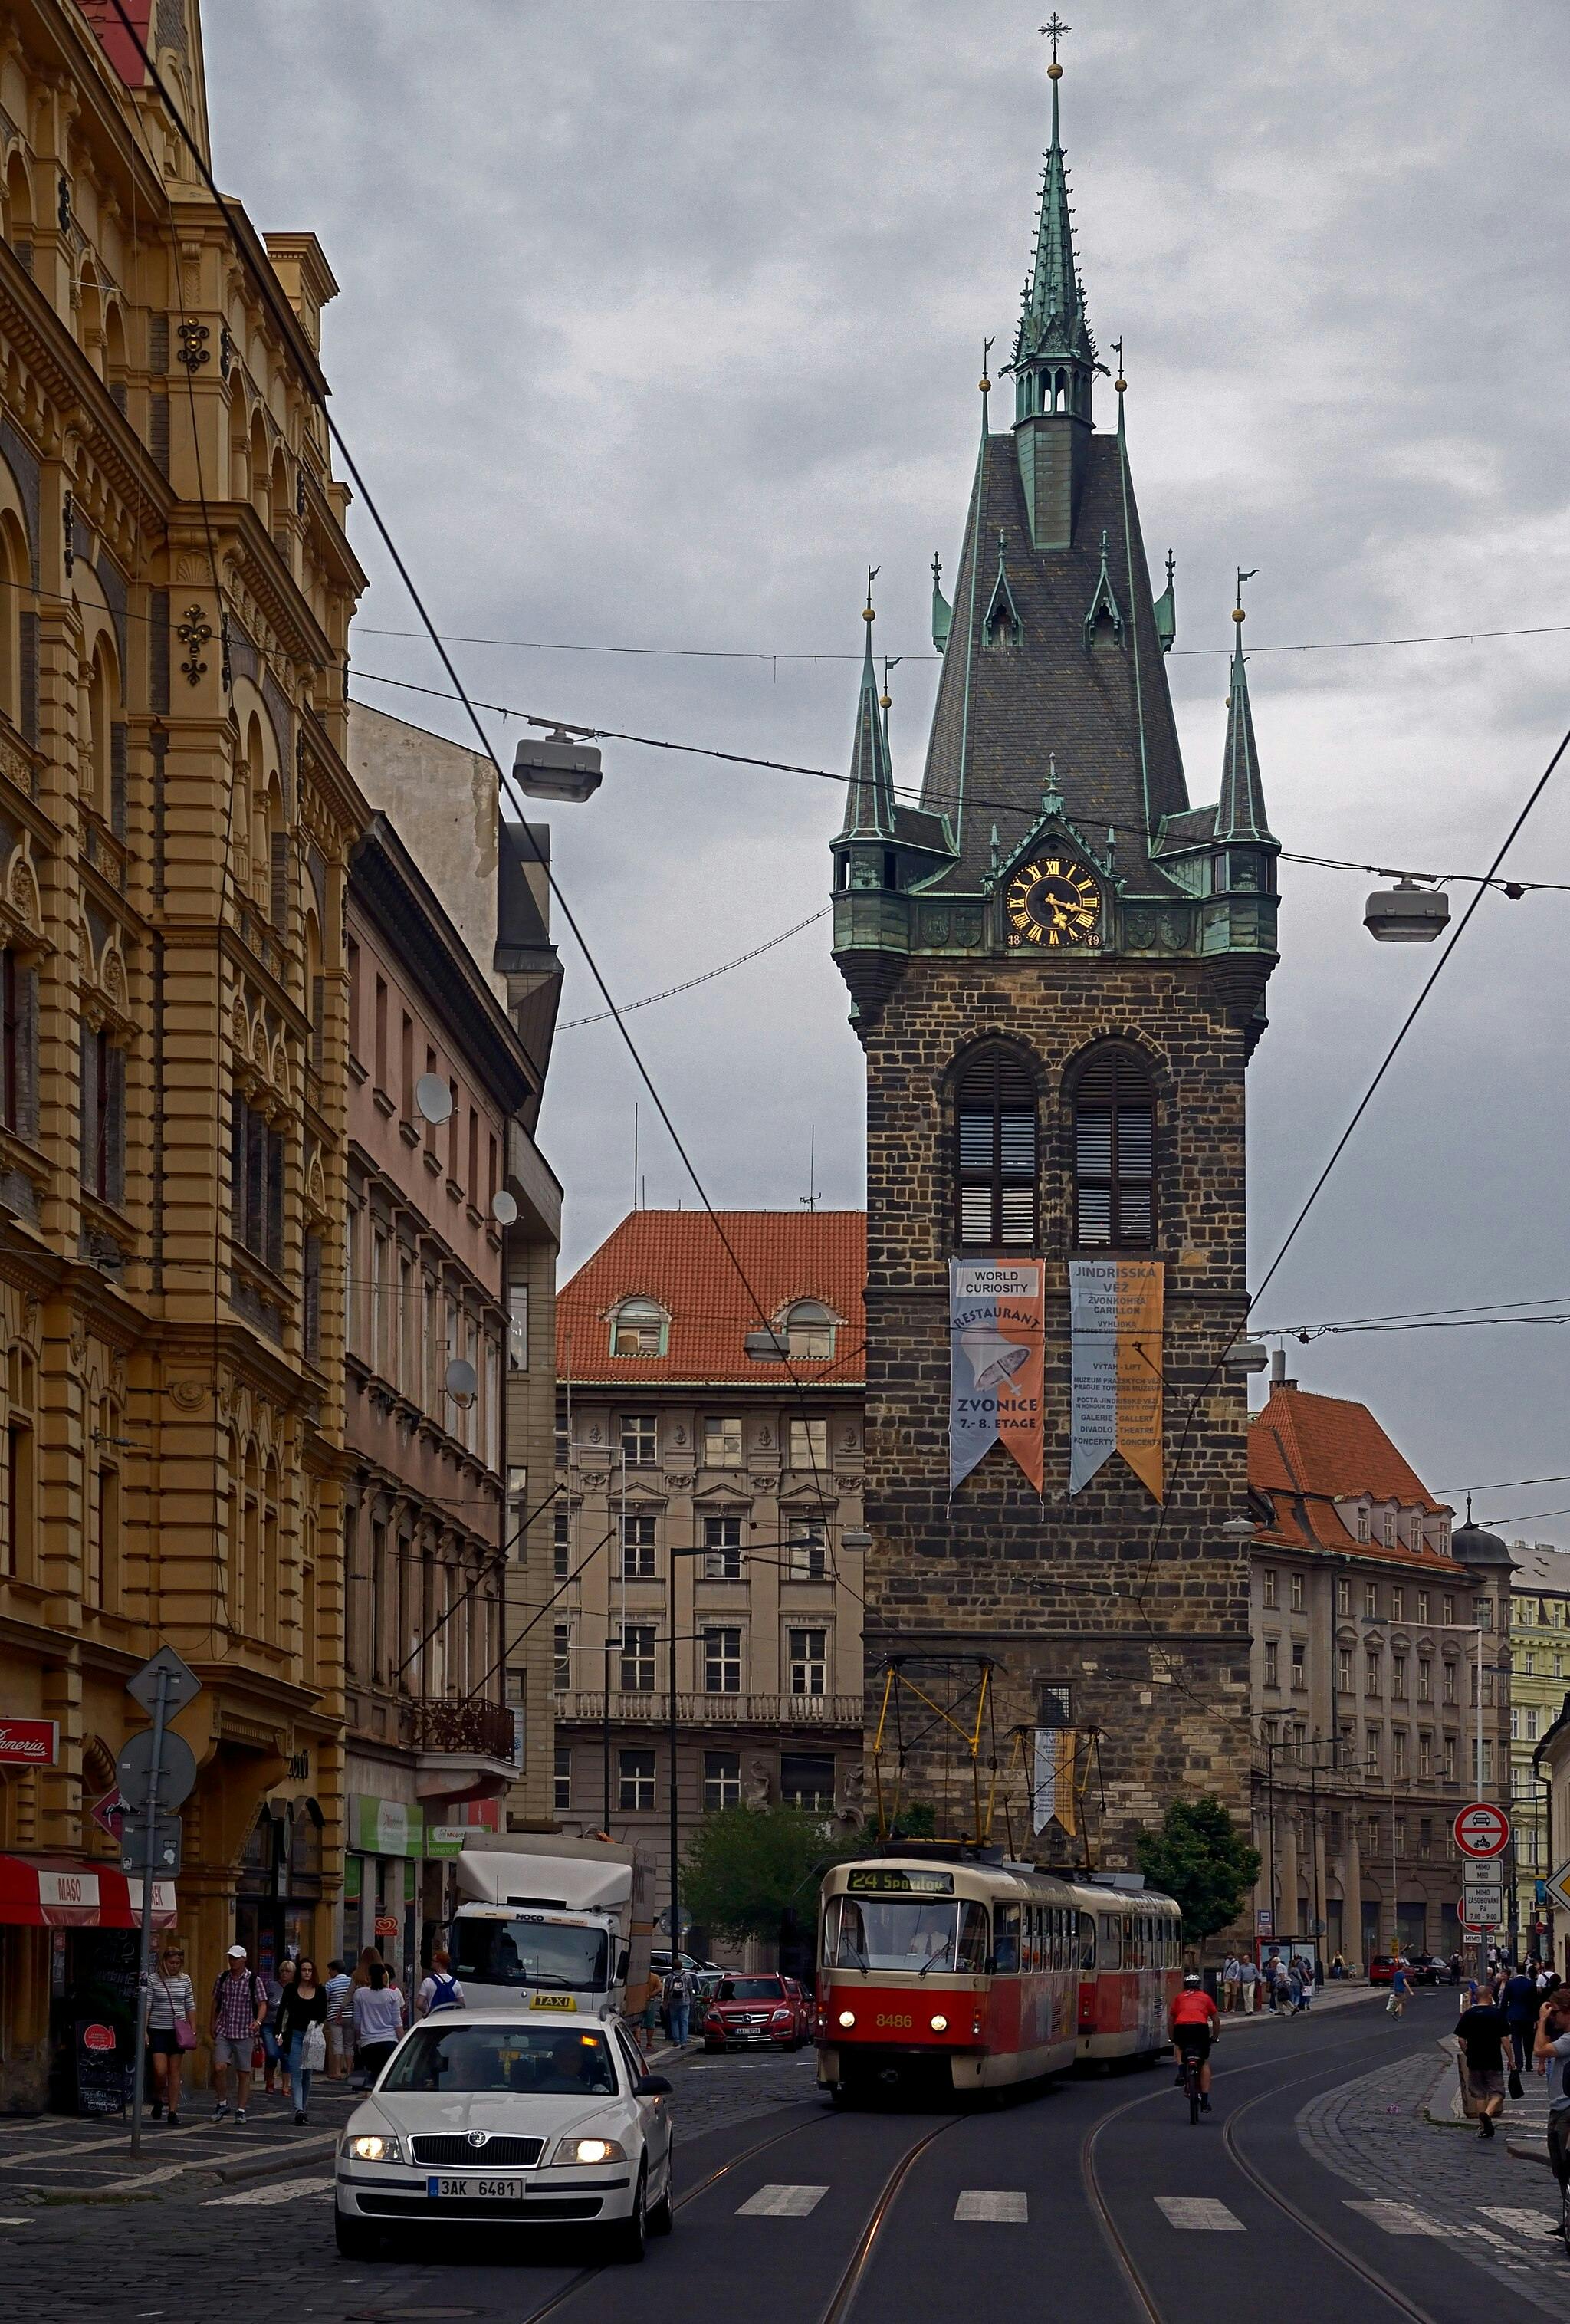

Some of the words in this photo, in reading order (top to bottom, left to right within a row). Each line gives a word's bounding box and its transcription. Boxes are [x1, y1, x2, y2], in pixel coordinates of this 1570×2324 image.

[975, 1272, 1018, 1280] WORLD
[966, 1284, 1028, 1293] CURIOSITY
[954, 1307, 1040, 1329] RESTAURANT
[957, 1399, 1037, 1412] ZVONICE
[979, 1419, 990, 1428] 8.
[994, 1419, 1036, 1428] ETAGE
[1073, 1437, 1114, 1445] KONCERTY
[852, 1872, 878, 1888] 24
[57, 1878, 81, 1902] MASO
[515, 1913, 544, 1921] HOCO
[537, 1997, 569, 2006] TAXI
[876, 2013, 912, 2028] 8486
[441, 2181, 467, 2195] 3AK
[478, 2181, 514, 2196] 6481
